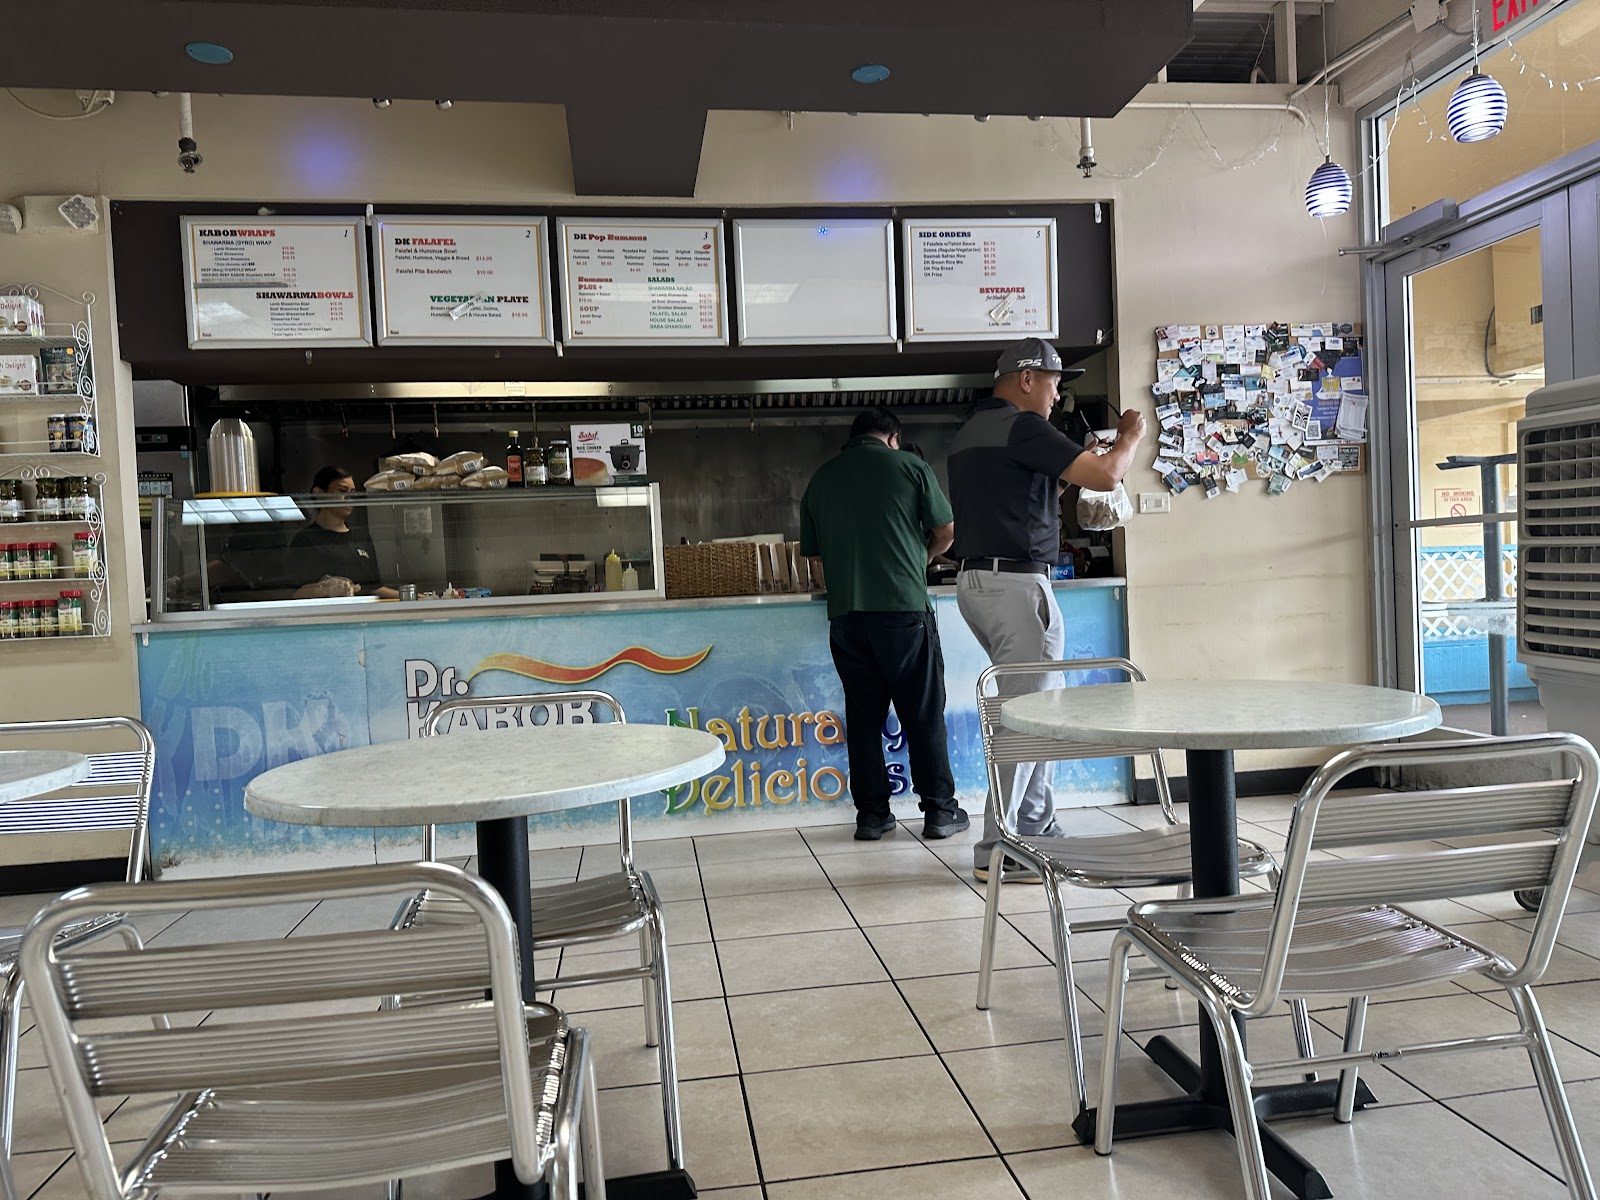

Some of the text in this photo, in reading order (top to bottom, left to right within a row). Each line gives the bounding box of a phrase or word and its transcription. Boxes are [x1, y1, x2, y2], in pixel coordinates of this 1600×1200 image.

[199, 229, 276, 237] KABOBWRAPS
[526, 230, 531, 238] 2
[703, 232, 708, 240] 3
[1036, 230, 1041, 238] 5
[632, 424, 642, 433] 10
[405, 659, 469, 698] Dr.
[664, 705, 908, 755] aturay
[658, 757, 908, 816] Delicios
